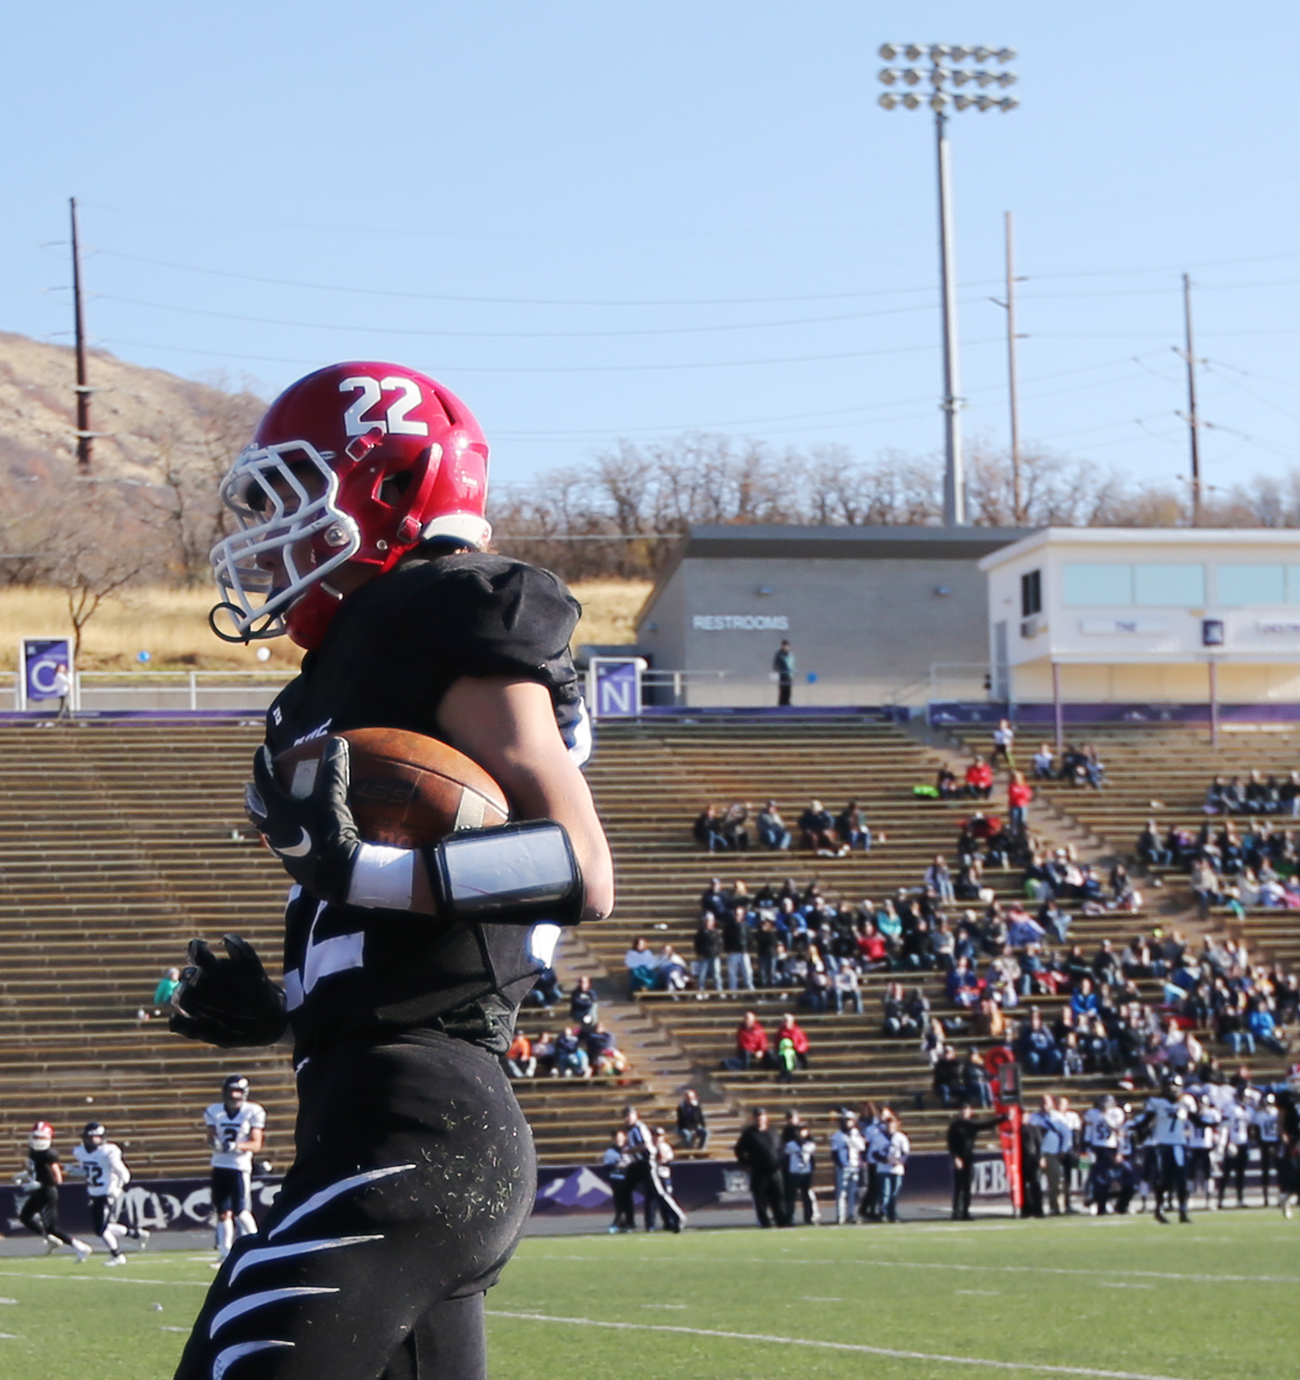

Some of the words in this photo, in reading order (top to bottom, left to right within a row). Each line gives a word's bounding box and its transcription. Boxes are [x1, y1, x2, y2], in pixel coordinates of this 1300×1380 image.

[339, 376, 429, 437] 22
[693, 615, 789, 630] RESTROOMS
[602, 681, 630, 712] N
